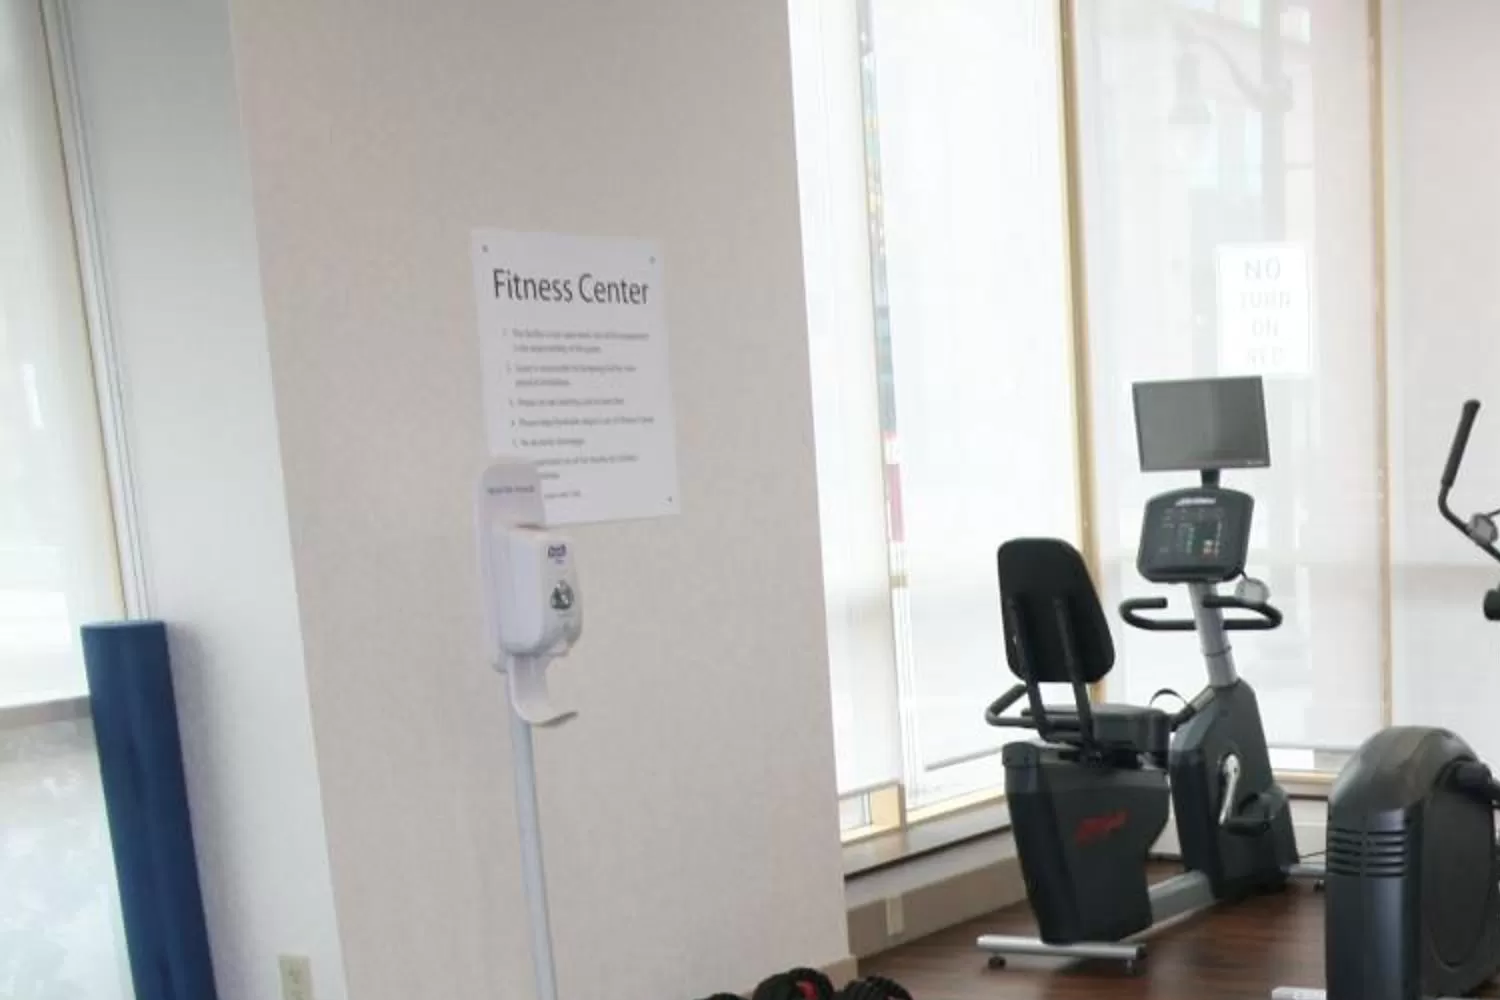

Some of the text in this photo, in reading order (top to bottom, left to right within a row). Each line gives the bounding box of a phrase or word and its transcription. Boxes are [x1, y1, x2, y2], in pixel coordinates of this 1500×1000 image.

[1244, 256, 1281, 281] NO
[493, 268, 650, 305] Fitness Center
[1239, 291, 1292, 309] TURN
[1251, 317, 1280, 337] ON
